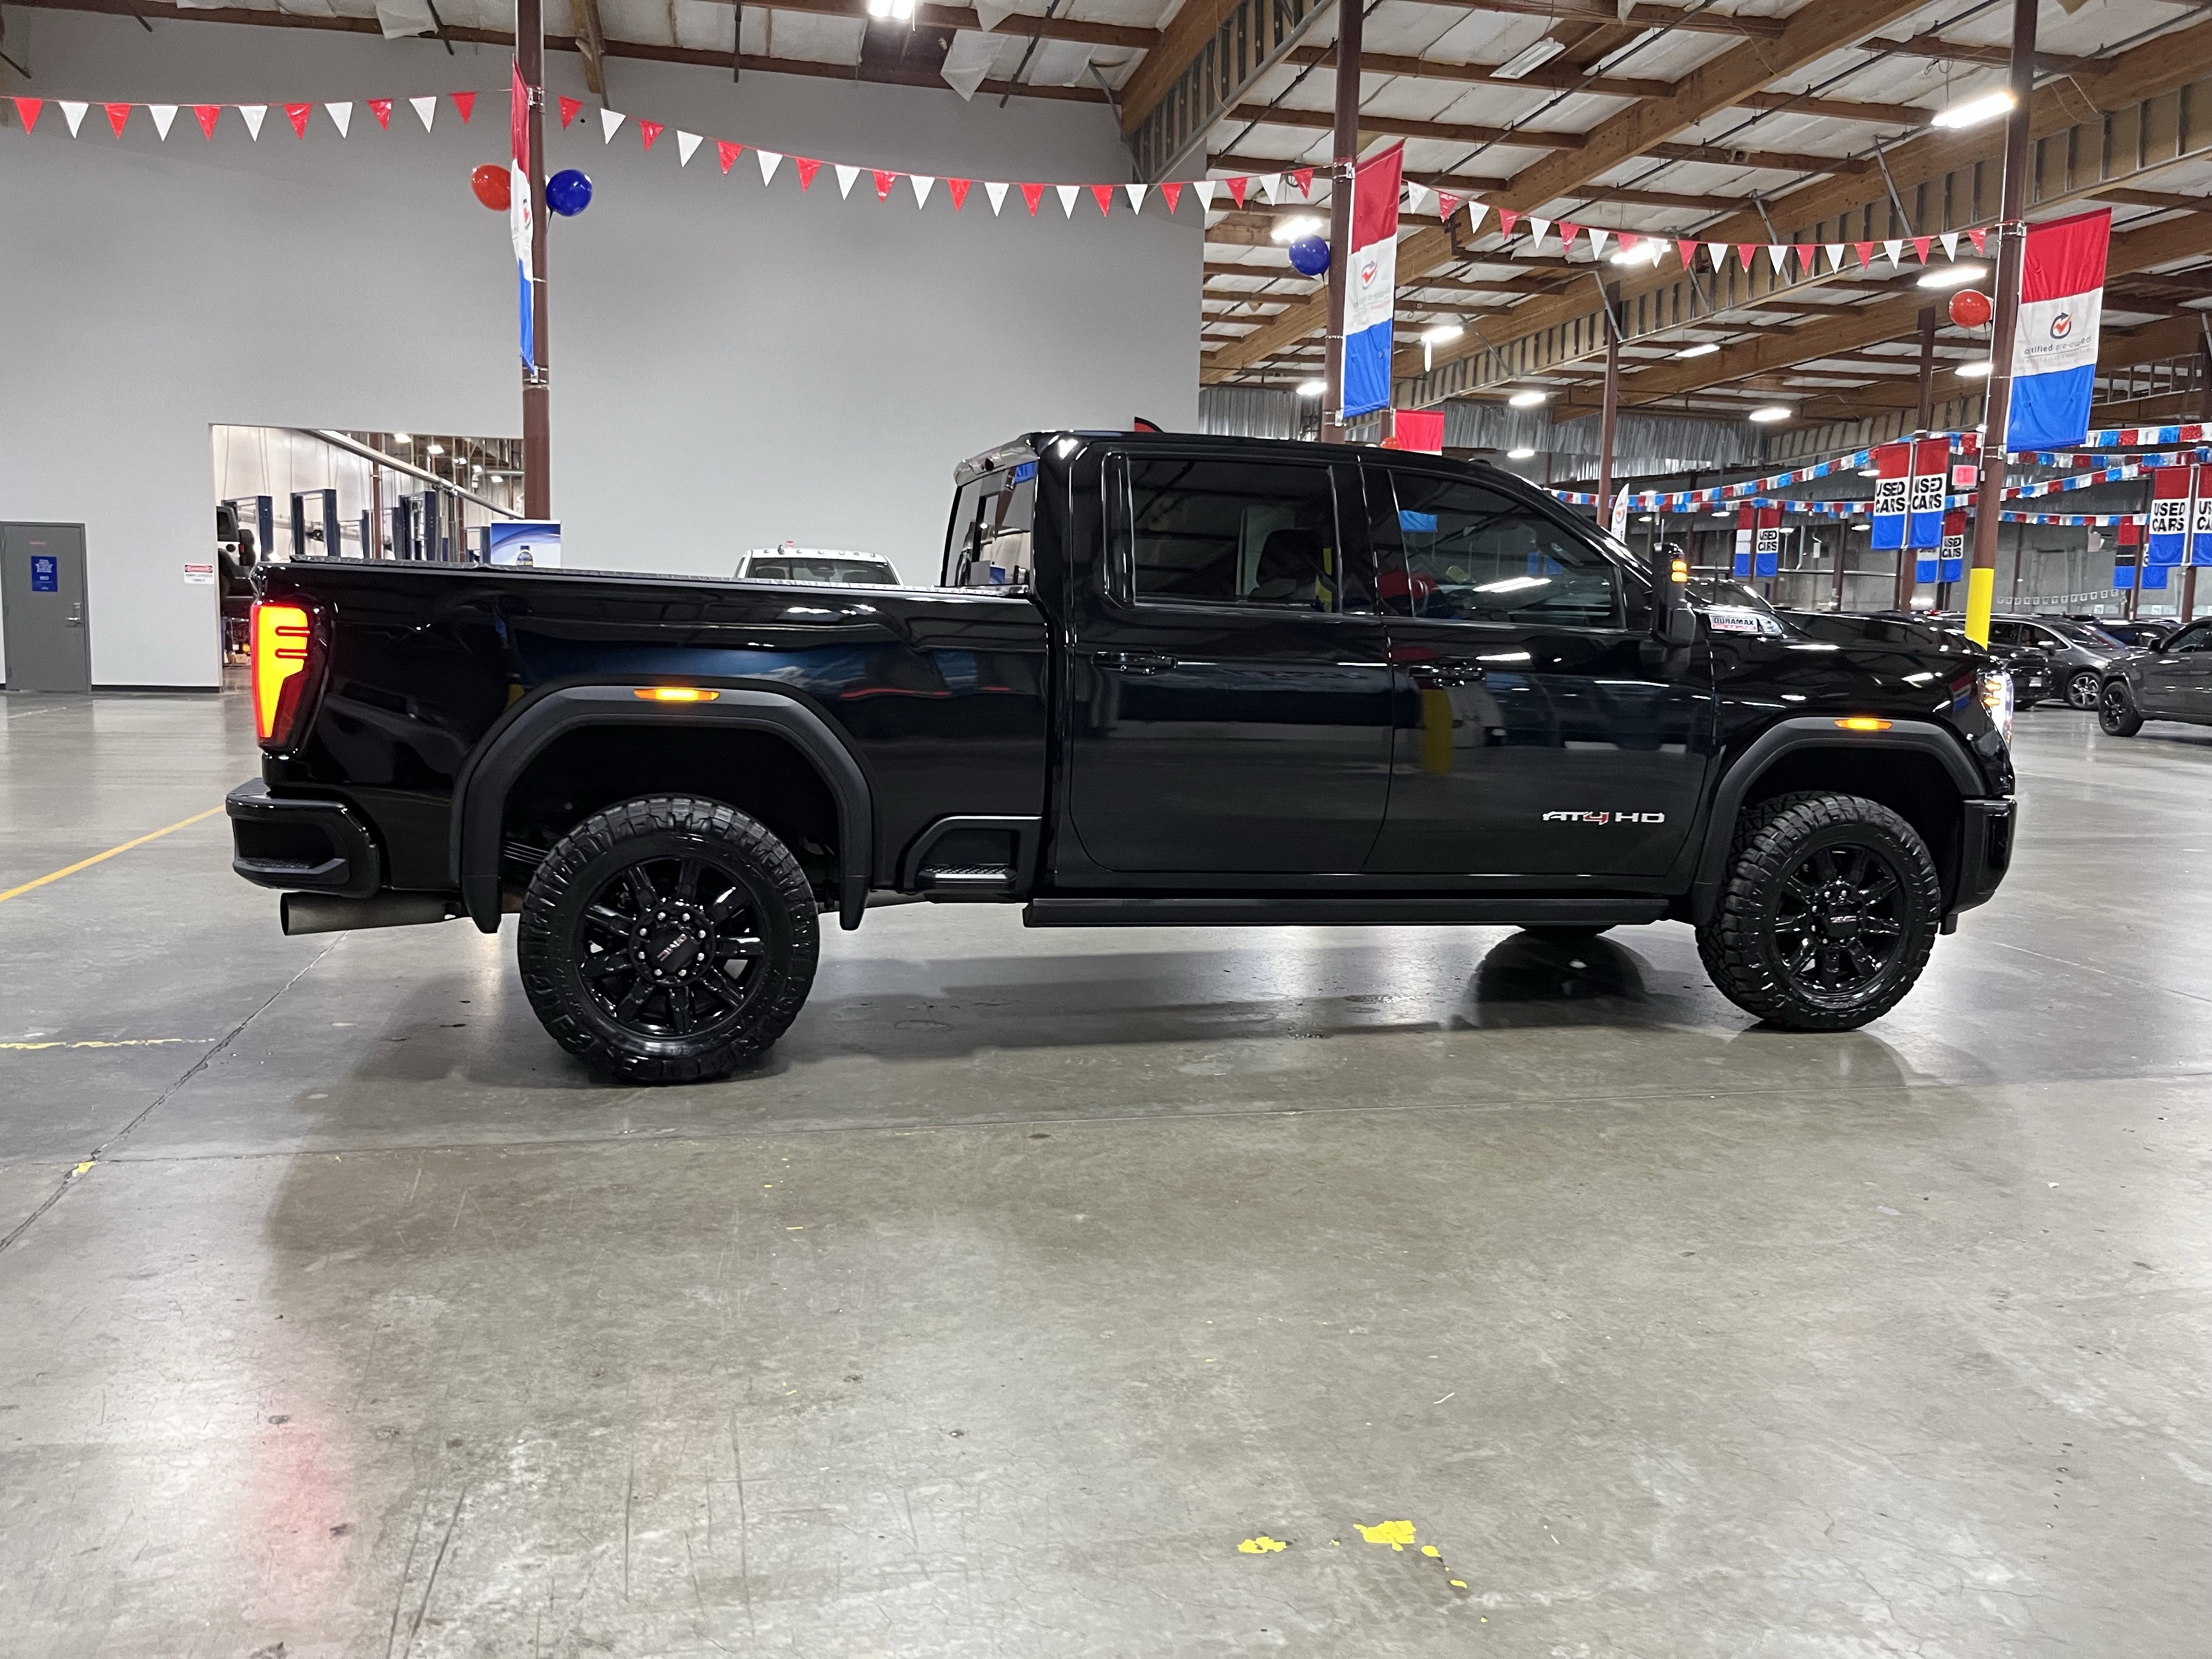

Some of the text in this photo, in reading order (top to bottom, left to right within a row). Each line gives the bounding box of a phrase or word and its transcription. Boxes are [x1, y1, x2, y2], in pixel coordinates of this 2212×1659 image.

[1876, 481, 1905, 496] USED
[1914, 477, 1943, 493] USED
[1875, 497, 1905, 513] CARS
[1912, 493, 1942, 510] CARS
[2154, 502, 2186, 516] USED
[2152, 517, 2185, 532] CARS
[1714, 617, 1754, 625] DURAMAX
[1543, 811, 1665, 825] AT4 HD
